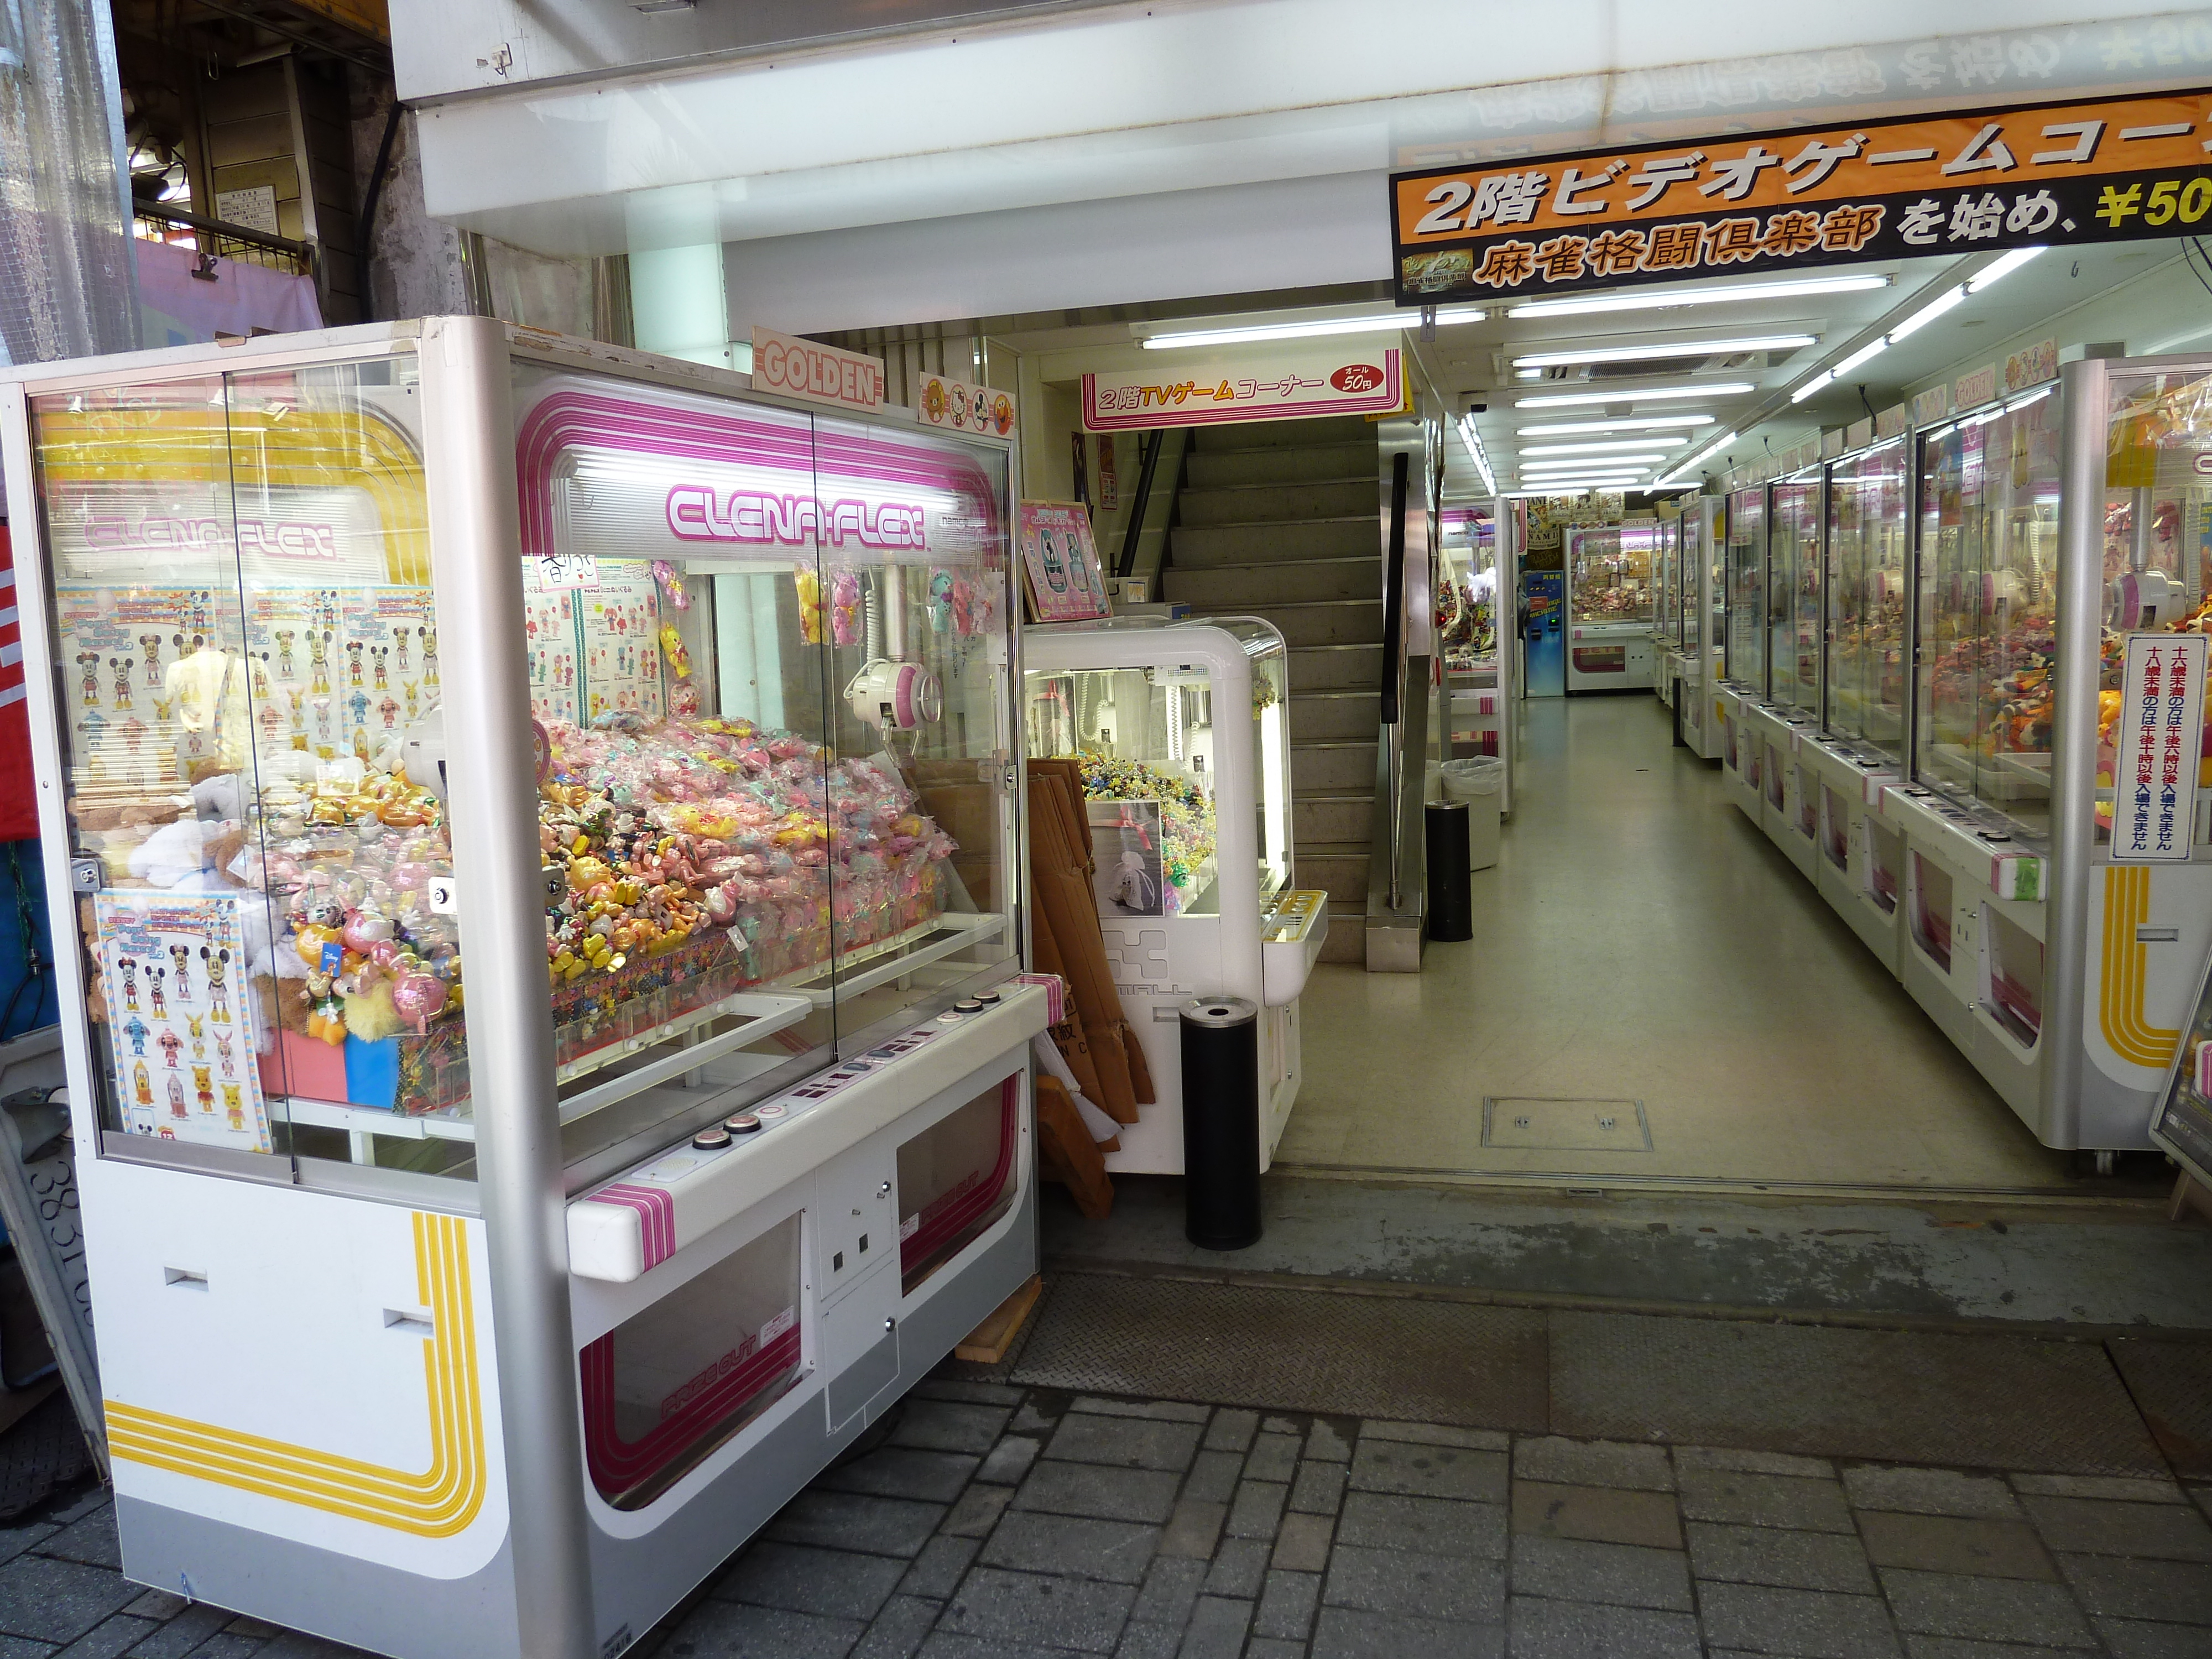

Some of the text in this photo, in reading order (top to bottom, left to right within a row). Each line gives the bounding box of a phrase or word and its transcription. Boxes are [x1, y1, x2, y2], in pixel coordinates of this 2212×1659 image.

[1414, 113, 2212, 234] 2階ビデオゲームコー
[1473, 206, 1886, 286] 麻雀格闘倶楽部
[763, 340, 876, 406] GOLDEN
[1098, 374, 1325, 411] 2階TVゲームコーナー
[1342, 374, 1371, 390] 50円
[2130, 646, 2162, 851] 十八歳未満の方は午後十時以後入場できません
[2156, 646, 2188, 851] 十六歳未満の方は午後六時以後入場できません
[719, 1334, 757, 1375] OUT
